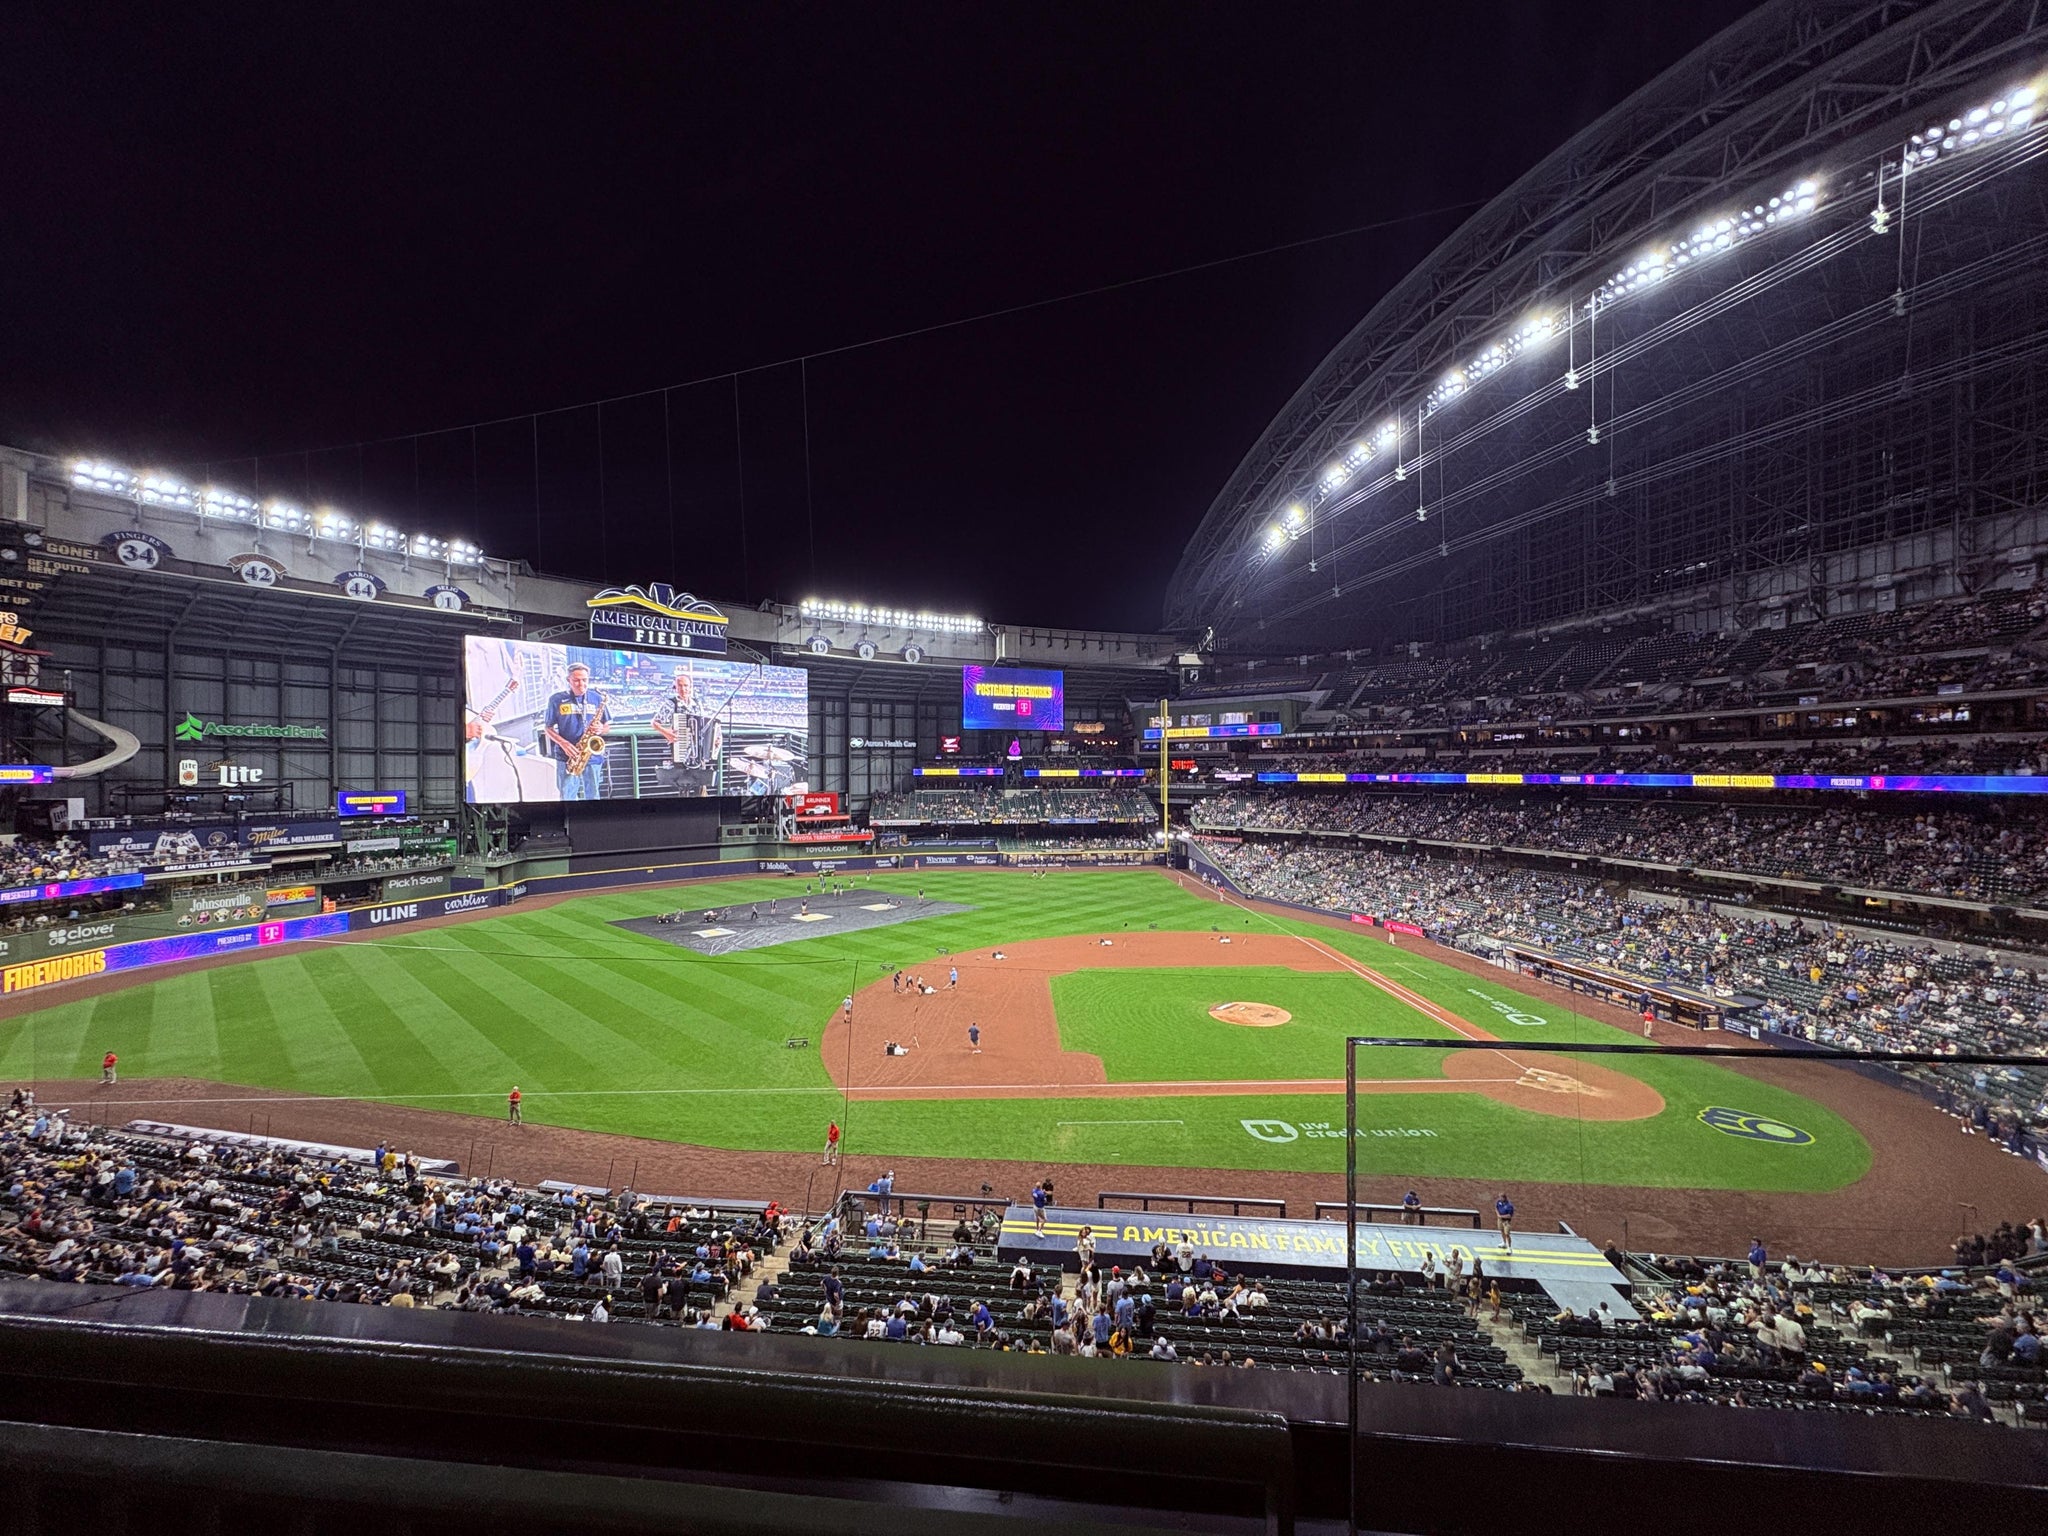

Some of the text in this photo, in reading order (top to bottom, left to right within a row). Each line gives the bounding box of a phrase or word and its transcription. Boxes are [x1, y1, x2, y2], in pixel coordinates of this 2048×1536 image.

[114, 532, 162, 547] FINGERS
[46, 542, 99, 560] GONE!
[121, 544, 156, 564] 34
[27, 557, 49, 568] GET
[245, 566, 273, 583] 42
[348, 572, 375, 581] AARON
[26, 581, 44, 591] UP
[349, 582, 373, 597] 44
[437, 585, 459, 594] SELIG
[444, 597, 453, 609] 1
[590, 608, 728, 638] AMERICAN FAMILY
[635, 629, 692, 647] FIELD
[815, 643, 826, 653] 19
[863, 647, 870, 657] 4
[976, 683, 1052, 698] POSTGAME FIREWORKS
[886, 740, 902, 748] Health
[181, 762, 197, 770] Lite
[217, 765, 264, 788] Lite
[1692, 775, 1730, 787] POSTGAME
[1731, 775, 1774, 788] FIREWORKS
[1830, 778, 1855, 787] PRESENTED
[247, 828, 289, 846] Miller
[269, 833, 334, 845] TIME, MILWAUKEE
[99, 843, 151, 852] BREW CREW
[805, 845, 848, 853] TOYOTA.COM
[164, 864, 187, 872] GREAT
[767, 862, 788, 870] Mobile
[418, 873, 444, 886] Save
[1, 890, 29, 901] PRESENTED
[29, 889, 38, 898] BY
[190, 894, 251, 912] Johnsonville
[444, 893, 489, 912] carbliss
[369, 904, 418, 924] ULINE
[67, 923, 116, 940] clover
[217, 934, 245, 946] PRESENTED
[244, 933, 252, 941] BY
[3, 950, 107, 994] FIREWORKS
[1299, 1122, 1330, 1131] uw
[1371, 1128, 1438, 1137] union
[1122, 1225, 1270, 1250] AMERICAN
[1386, 1239, 1474, 1262] FIELD
